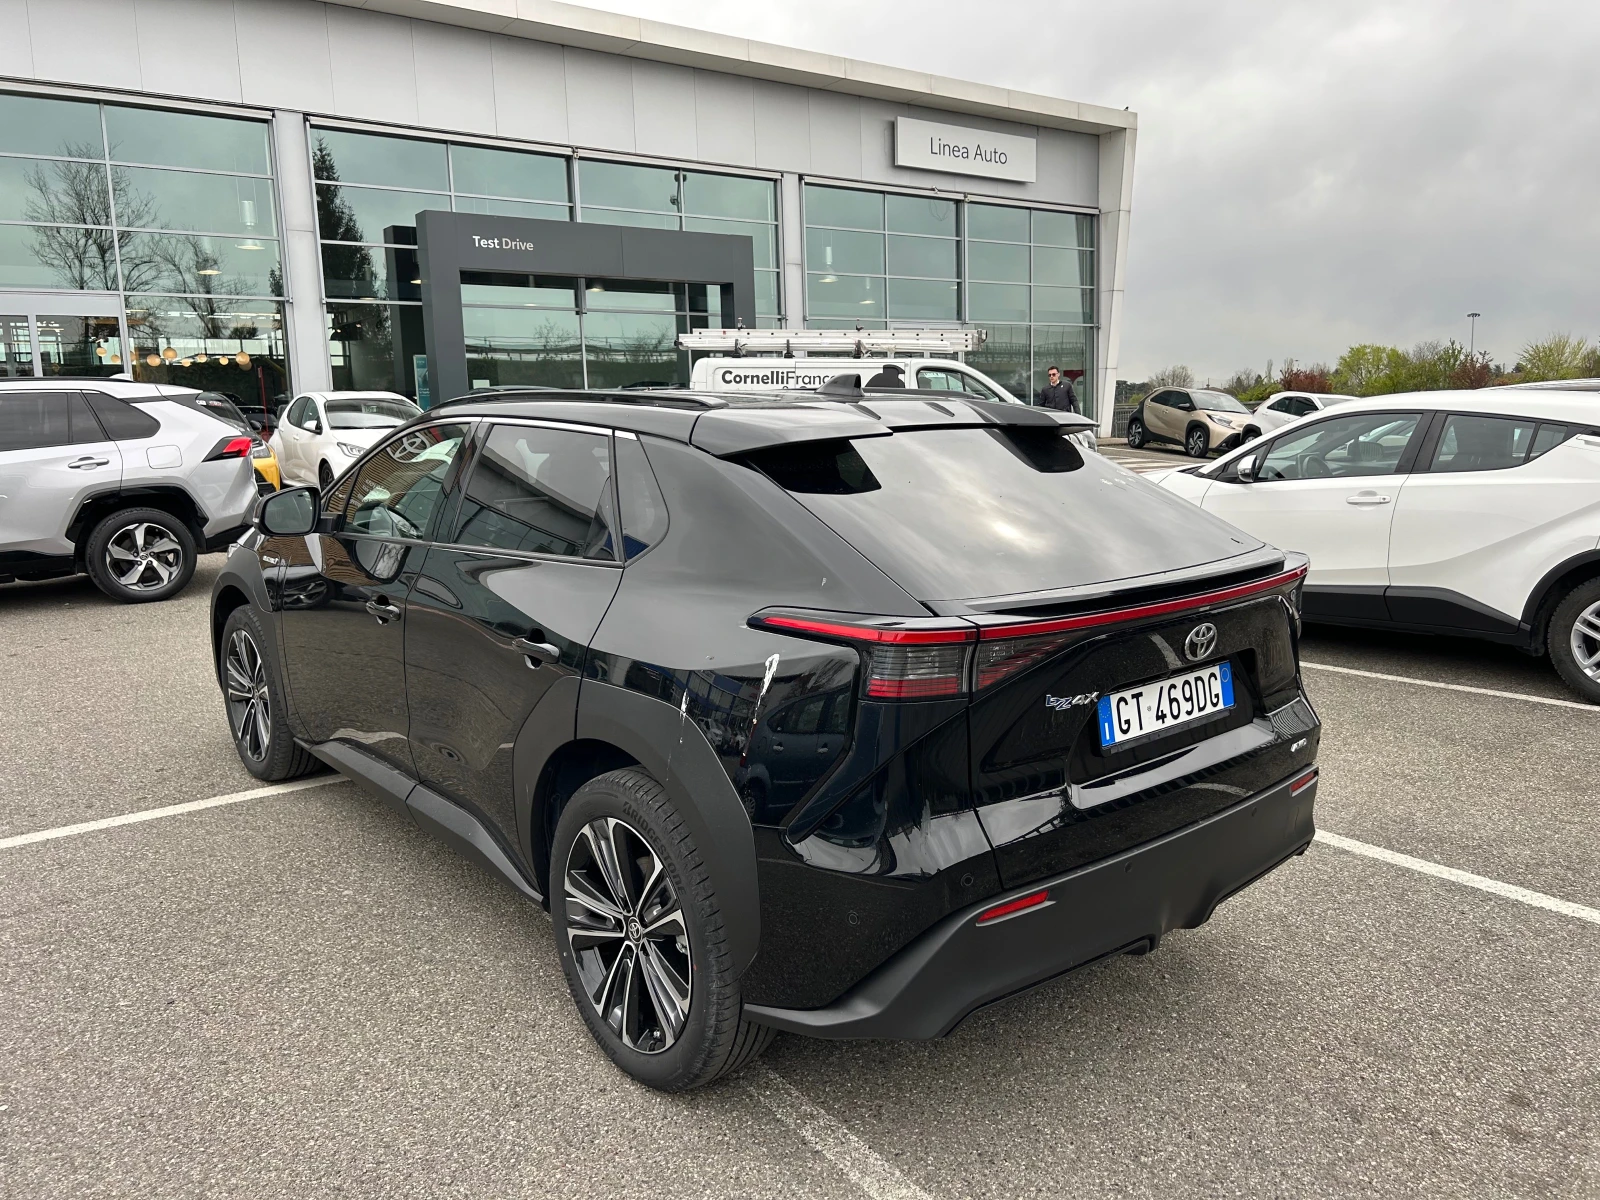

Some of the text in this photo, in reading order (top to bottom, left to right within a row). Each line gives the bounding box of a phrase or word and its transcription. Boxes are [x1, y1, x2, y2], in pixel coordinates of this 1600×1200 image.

[930, 137, 1008, 165] Linea Auto
[472, 235, 534, 251] Test Drive
[1116, 671, 1220, 735] GT 469DG
